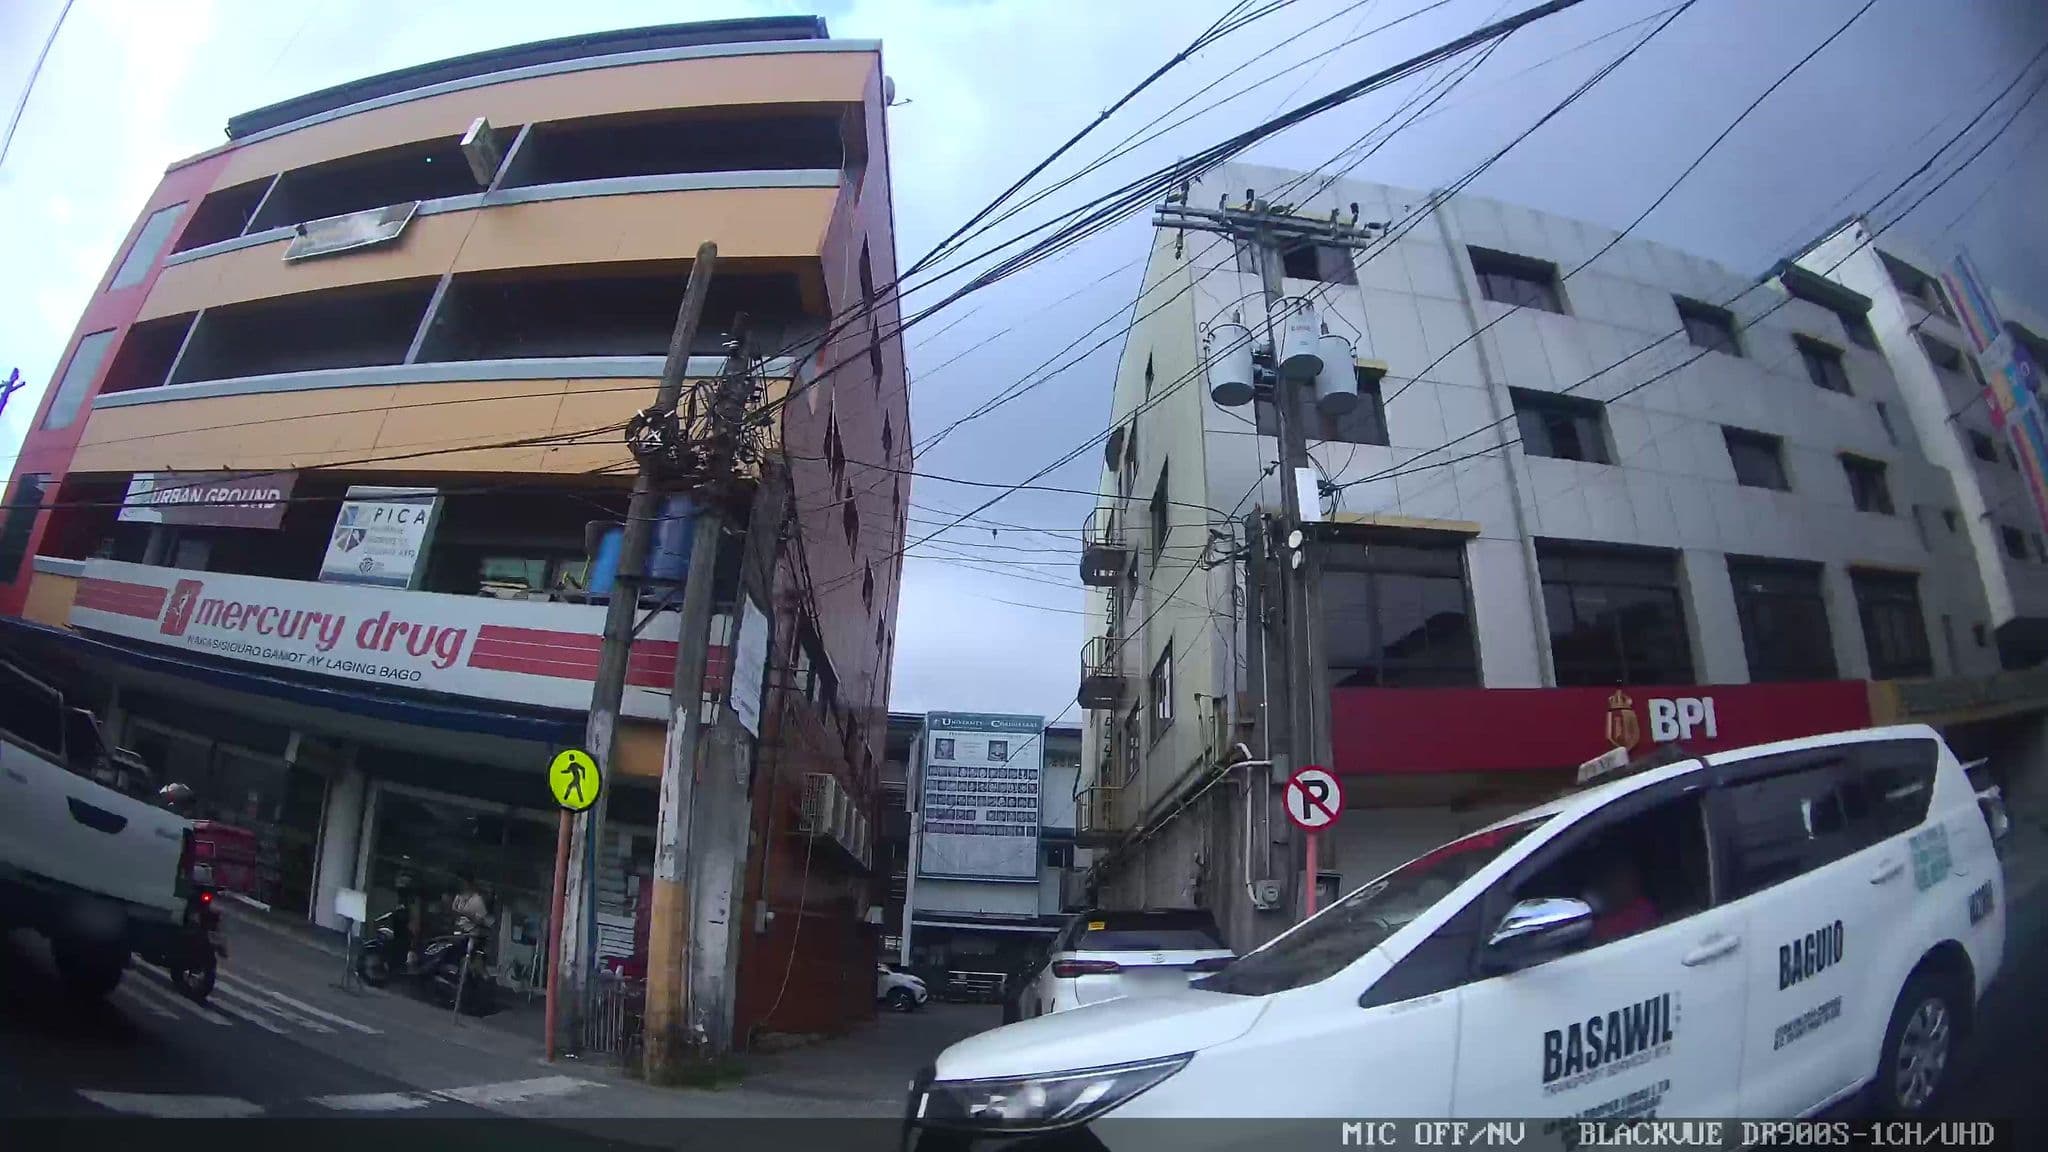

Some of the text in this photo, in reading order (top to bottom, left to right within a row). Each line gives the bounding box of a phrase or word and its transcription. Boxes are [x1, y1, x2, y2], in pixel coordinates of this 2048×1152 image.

[151, 487, 281, 509] URBAN GROUND
[373, 507, 426, 525] PICA
[194, 598, 467, 669] mercury drug
[262, 648, 306, 662] GAMOT
[307, 655, 324, 668] AY
[326, 659, 376, 675] LAGING
[379, 666, 422, 682] BAGO
[1647, 696, 1718, 743] BPI
[1302, 780, 1329, 820] P
[1779, 919, 1844, 991] BAGUIO
[1543, 992, 1673, 1084] BASAWIL
